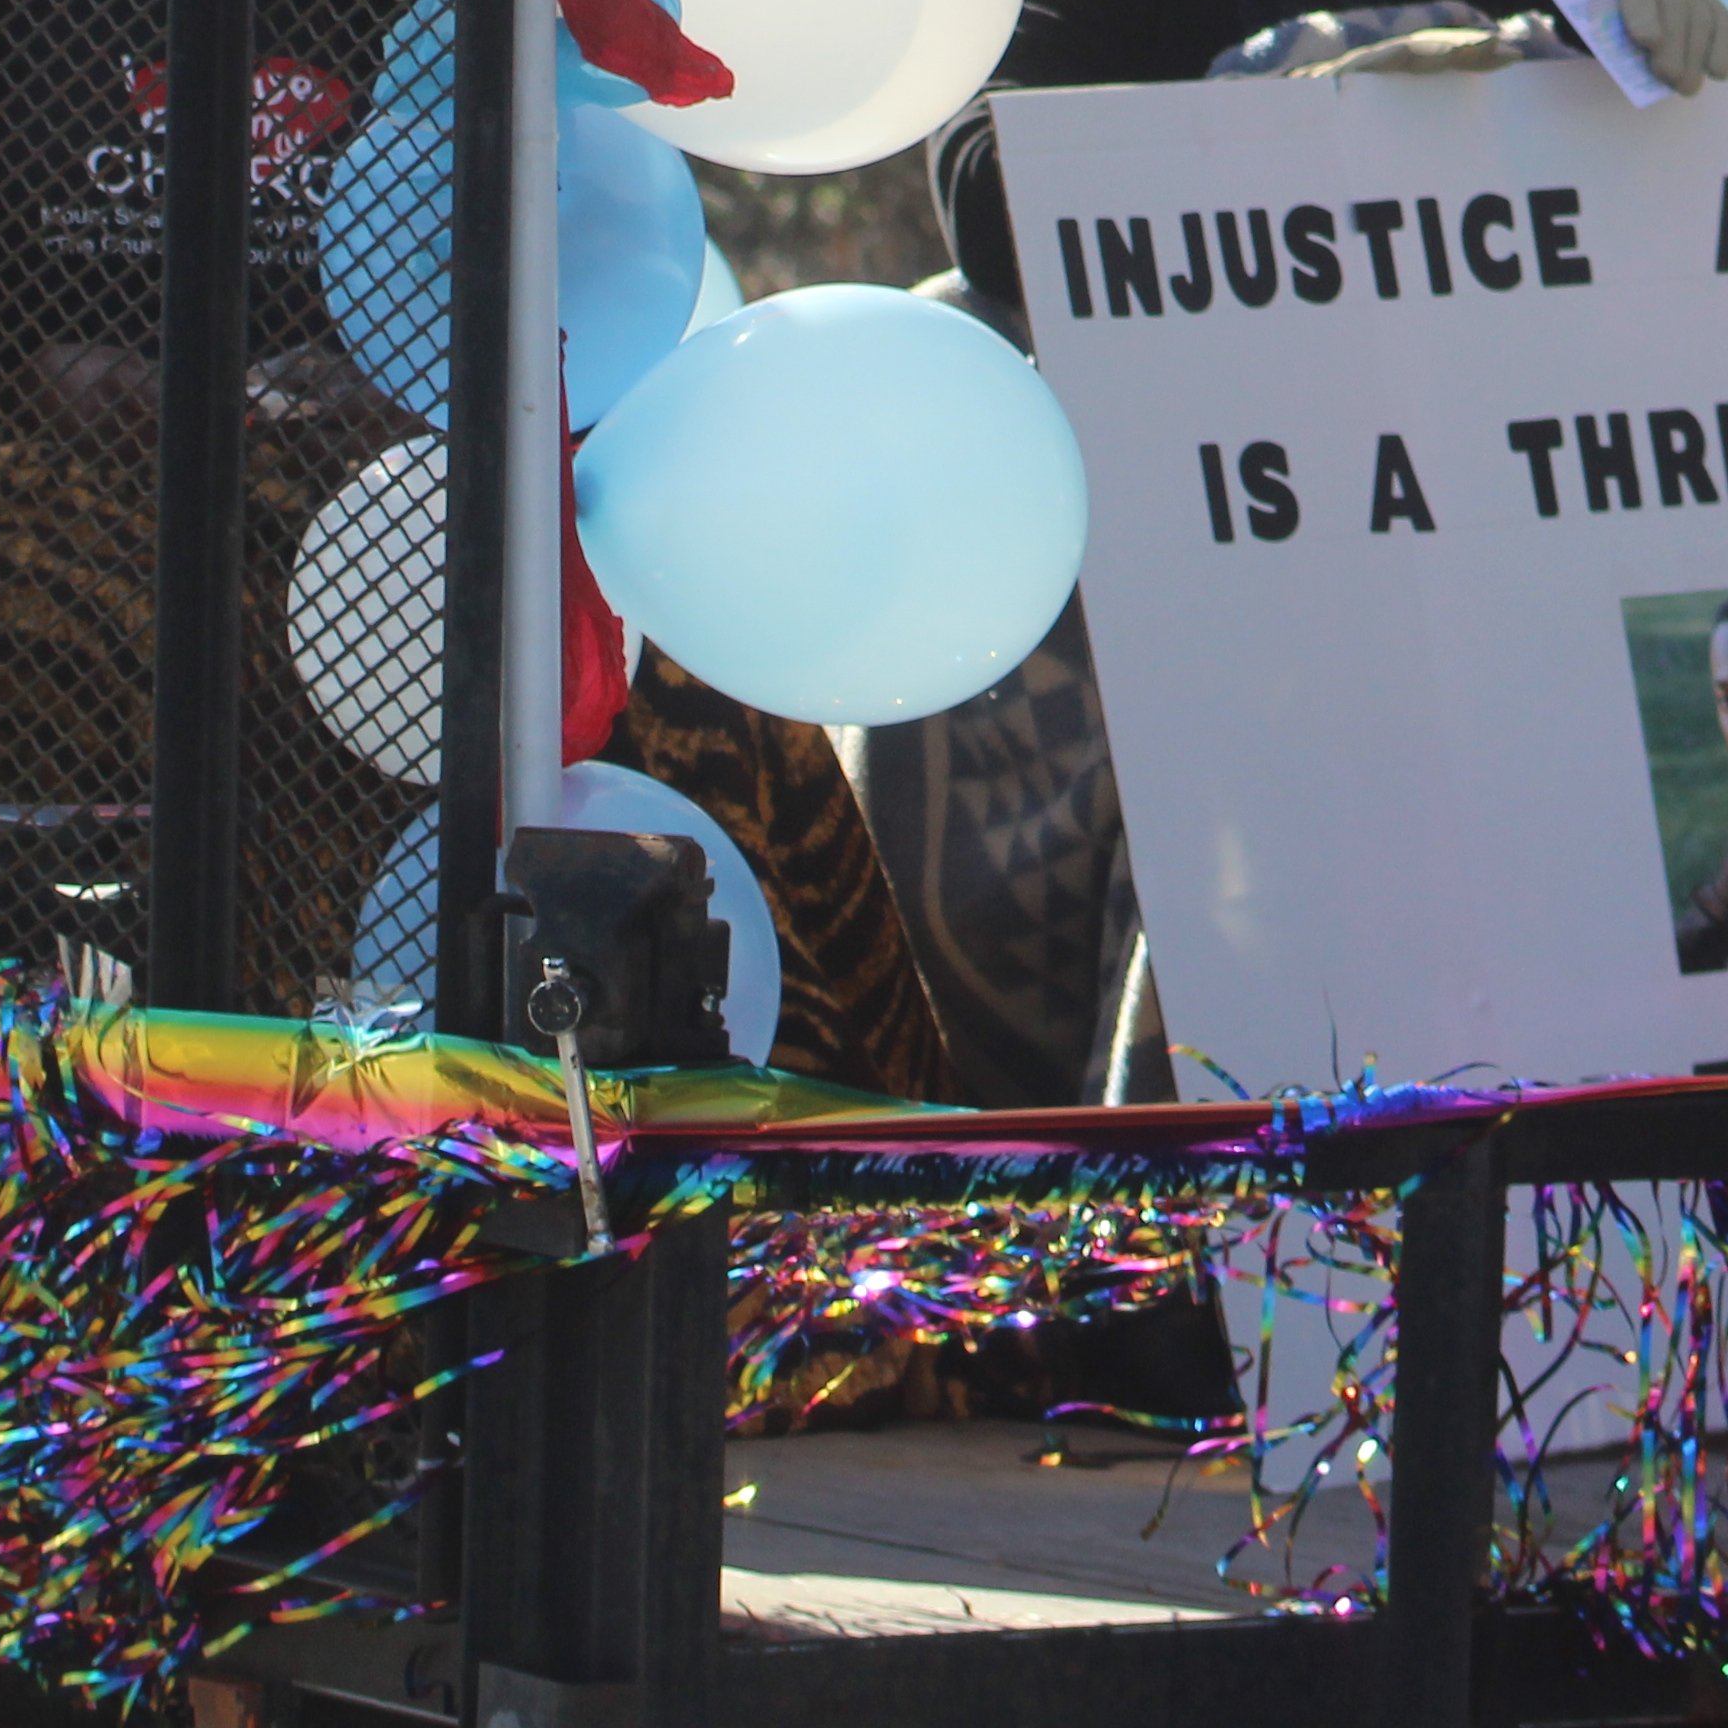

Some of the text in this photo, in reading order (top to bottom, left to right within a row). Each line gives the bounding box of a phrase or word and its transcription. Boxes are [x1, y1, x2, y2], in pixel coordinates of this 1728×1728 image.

[1056, 187, 1593, 319] INJUSTICE
[1199, 440, 1301, 543] IS
[1369, 433, 1436, 533] A
